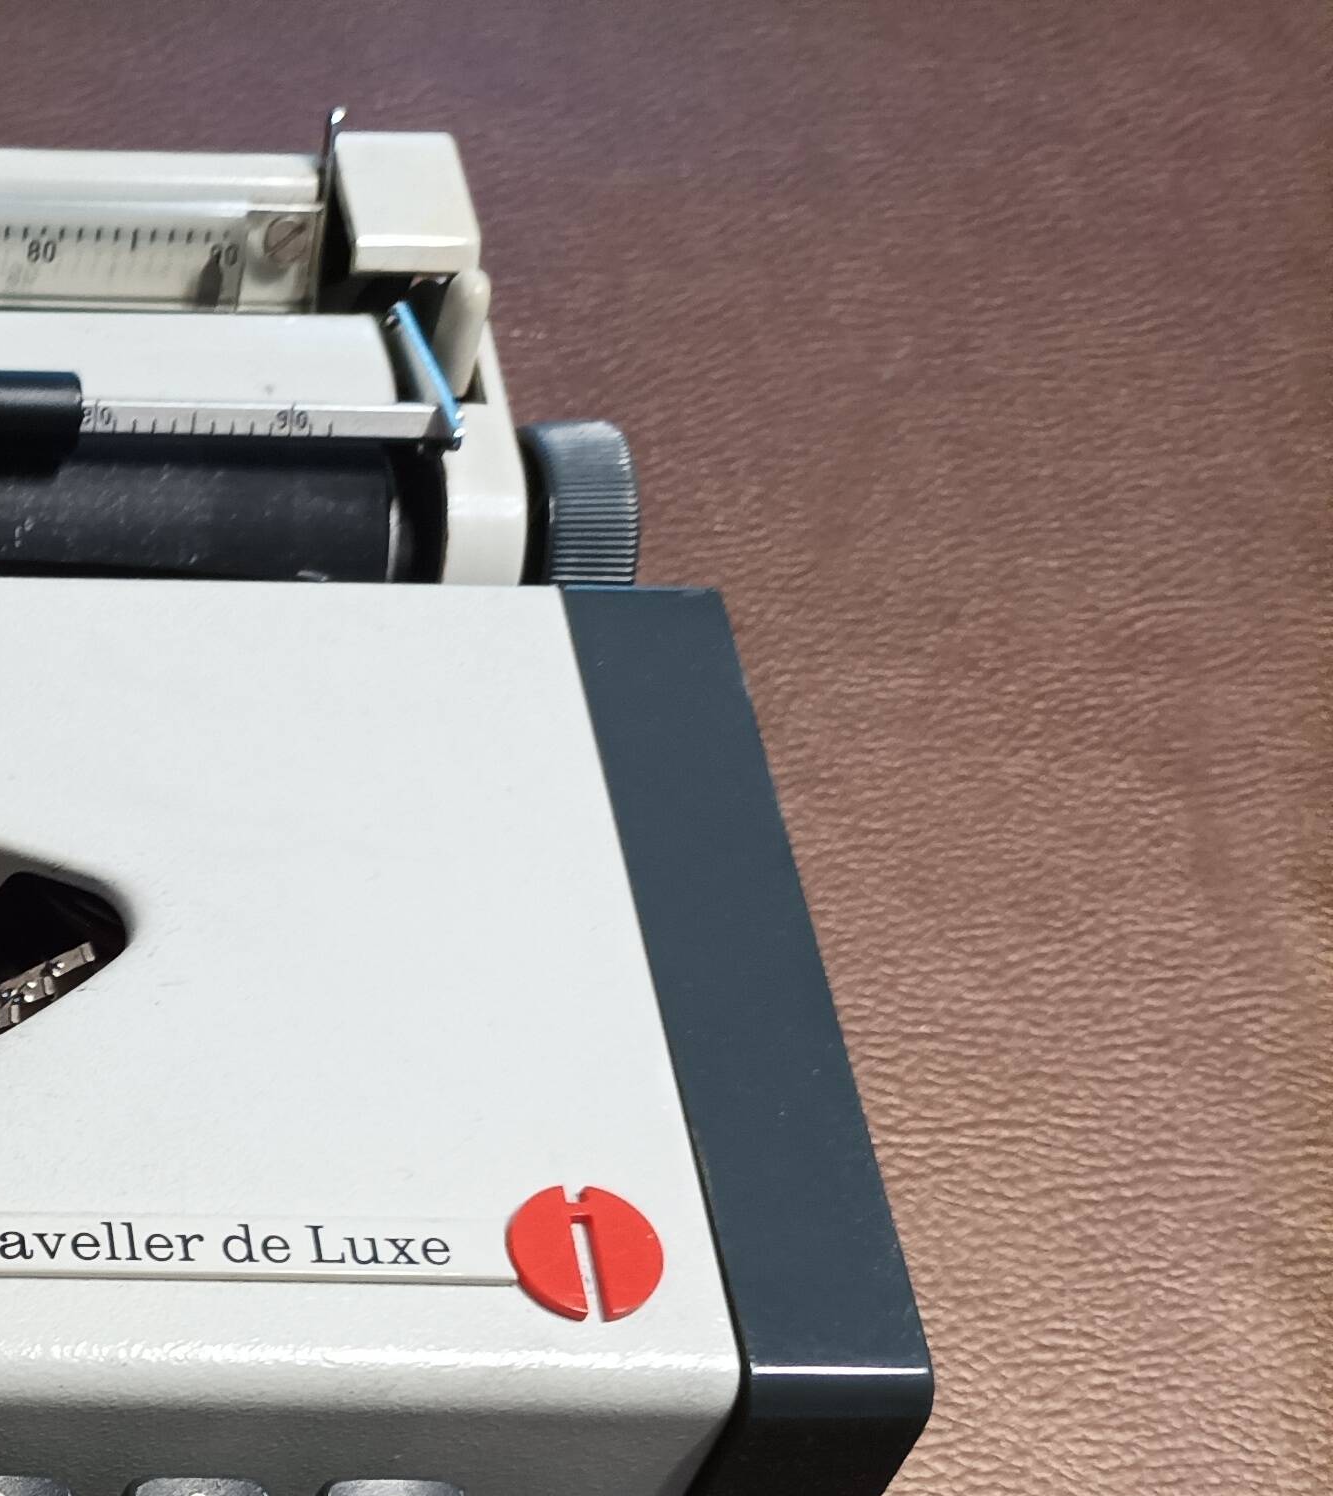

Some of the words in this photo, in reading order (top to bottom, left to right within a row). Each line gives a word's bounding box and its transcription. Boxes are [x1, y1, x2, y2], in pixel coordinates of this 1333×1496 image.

[26, 239, 57, 263] 80
[276, 410, 309, 429] 90
[222, 1223, 291, 1265] de
[305, 1225, 451, 1266] Luxe
